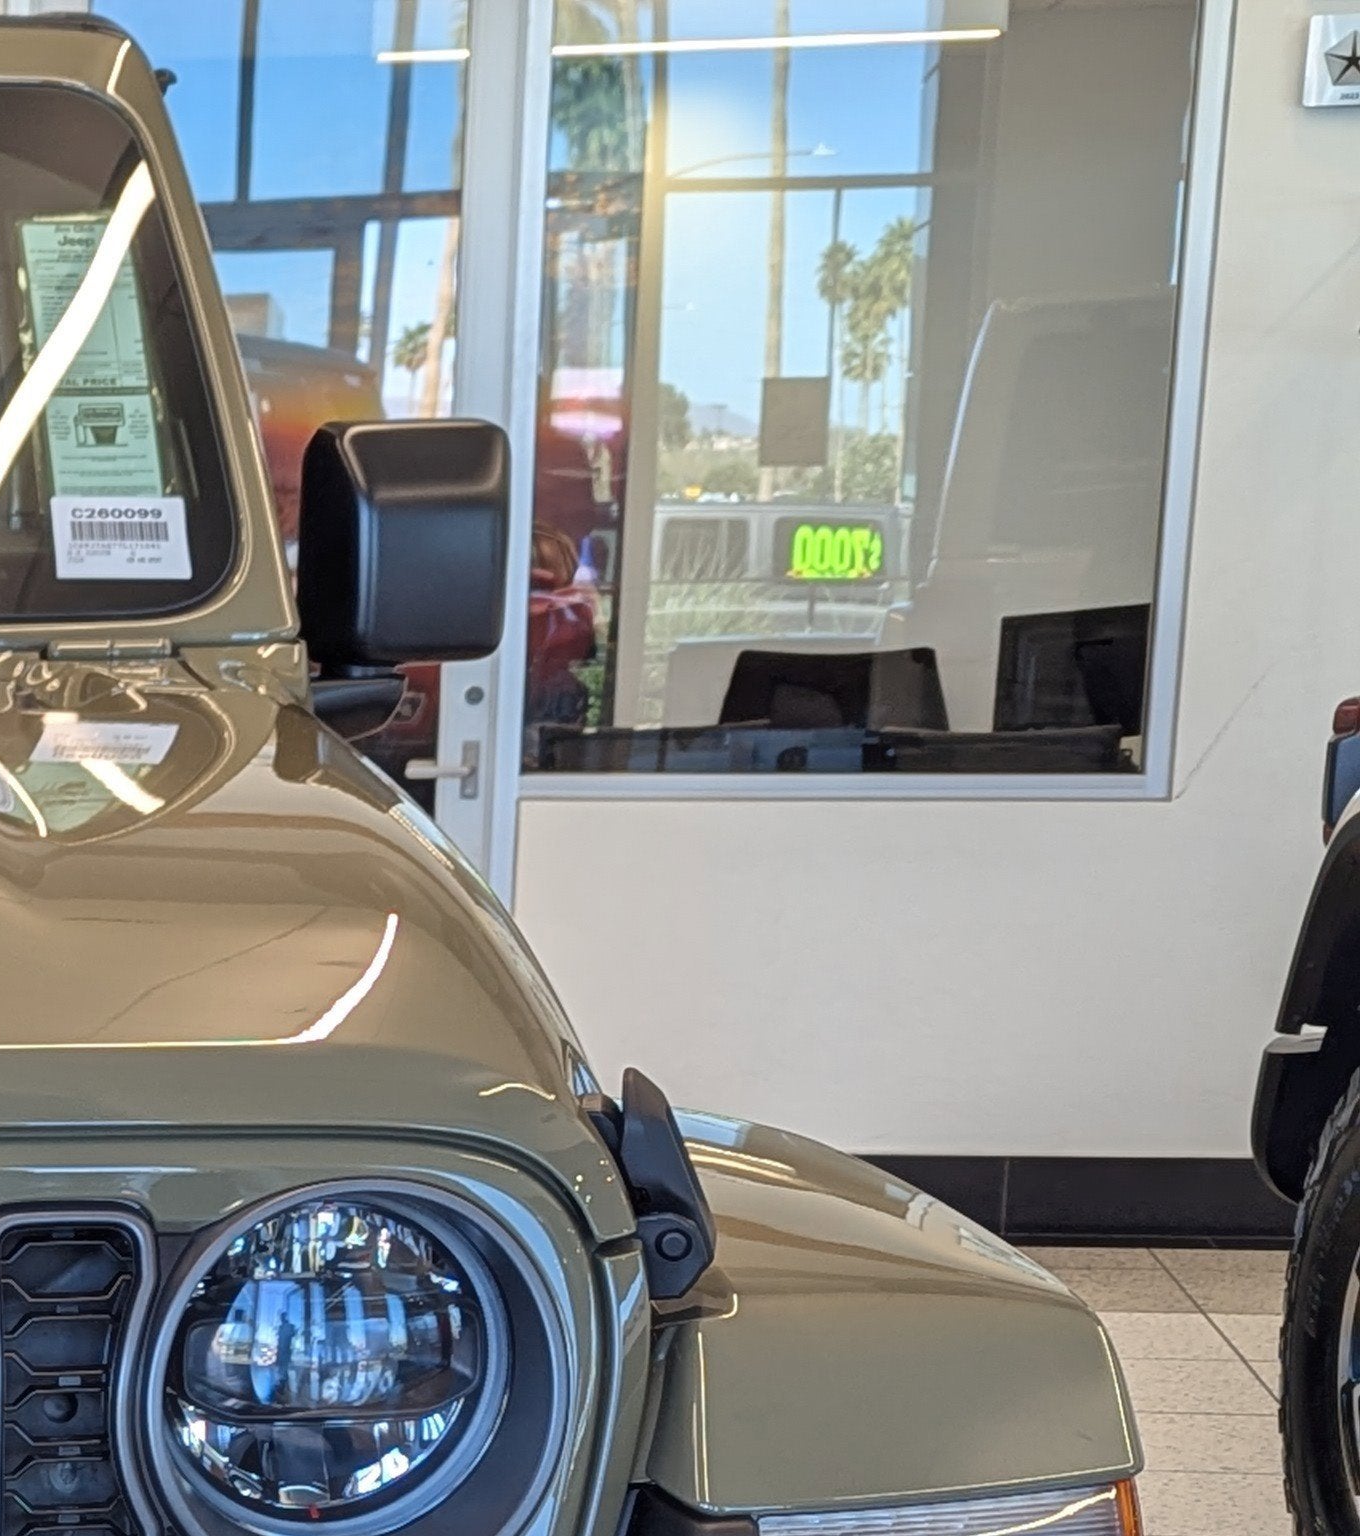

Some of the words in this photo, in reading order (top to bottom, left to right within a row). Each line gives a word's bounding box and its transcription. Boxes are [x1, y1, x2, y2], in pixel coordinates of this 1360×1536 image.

[57, 235, 96, 247] Jeep
[83, 378, 117, 386] PRICE
[70, 508, 163, 519] C260099
